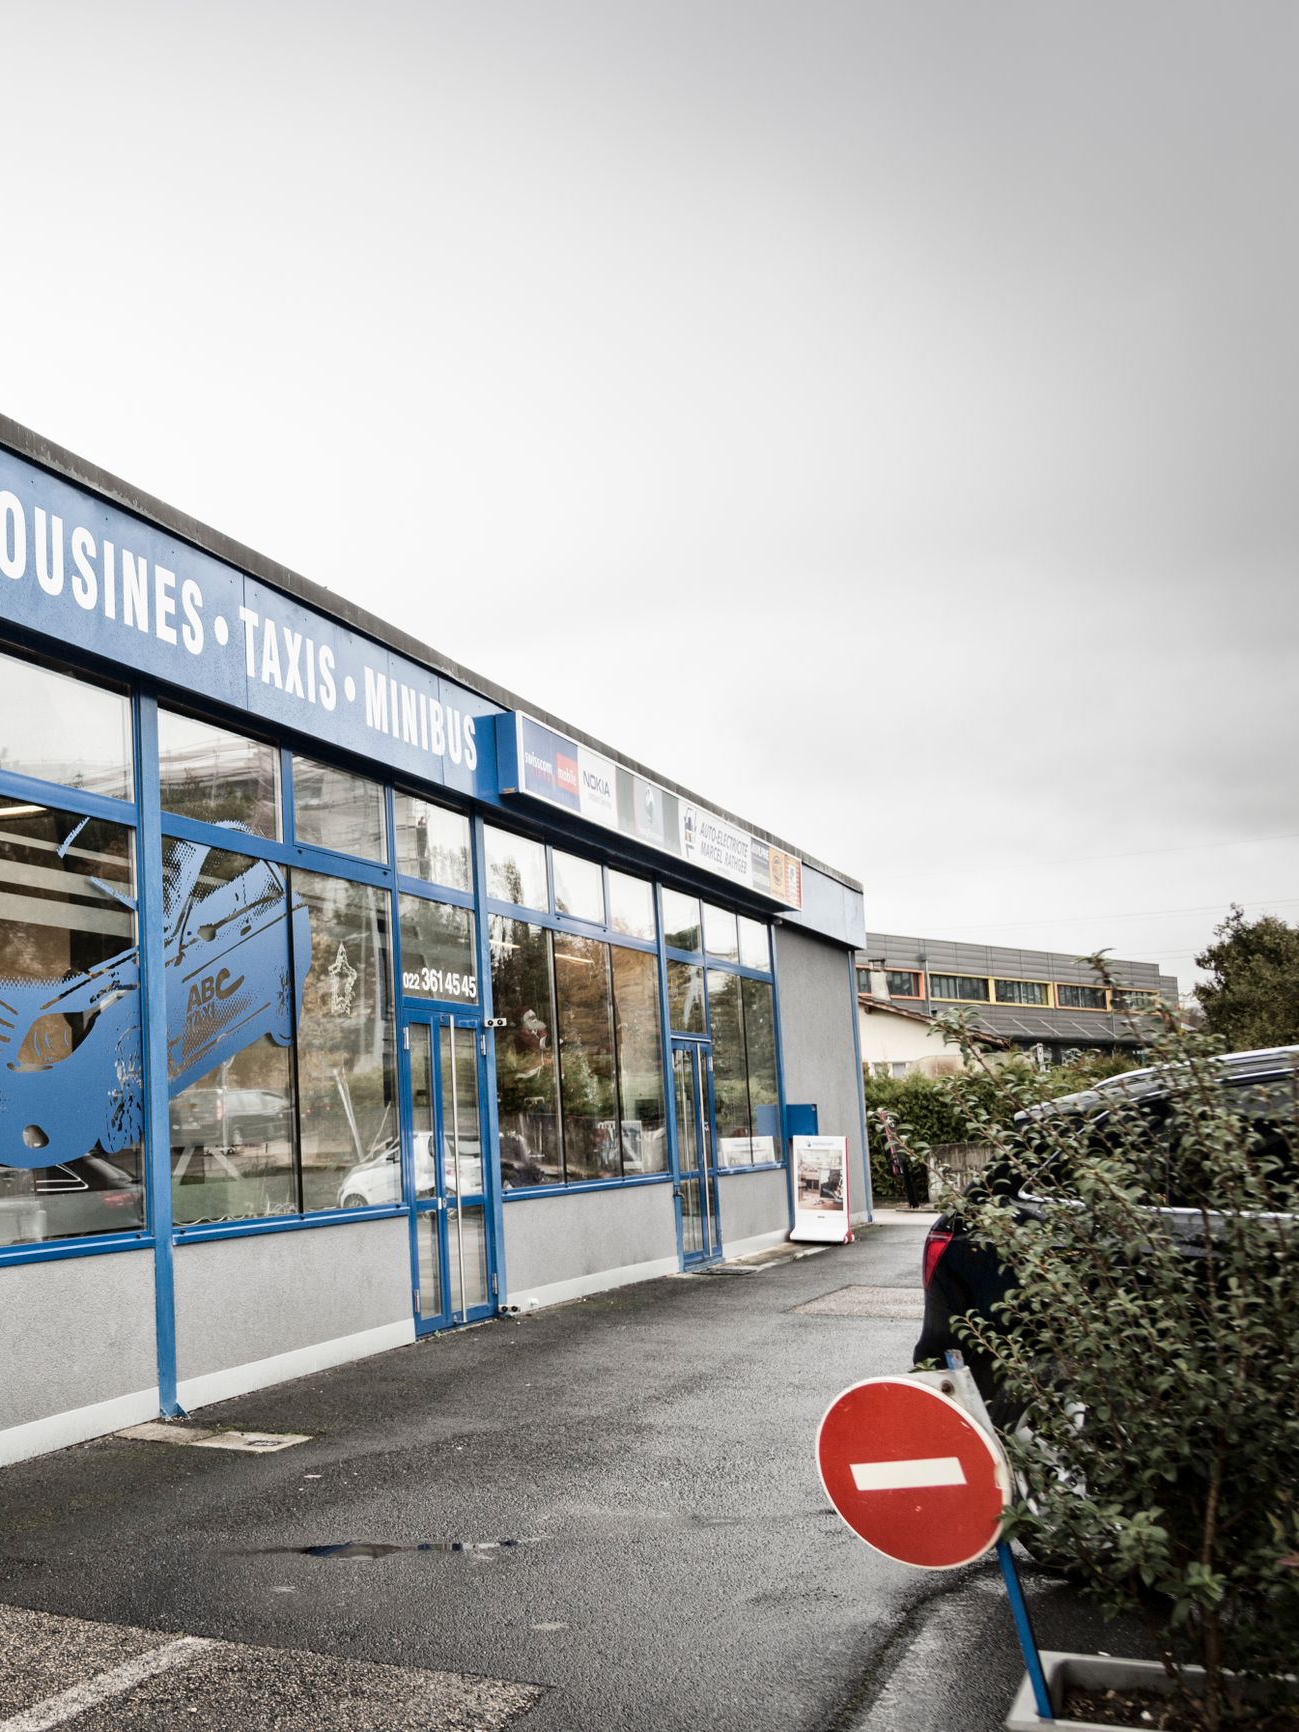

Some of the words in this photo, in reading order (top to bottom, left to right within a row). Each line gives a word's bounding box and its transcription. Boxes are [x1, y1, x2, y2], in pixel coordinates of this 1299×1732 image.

[239, 604, 337, 711] TAXIS
[364, 665, 478, 772] MINIBUS
[524, 751, 553, 774] swisscom
[582, 770, 611, 797] NOKIA
[701, 841, 723, 864] MARCEL
[186, 967, 245, 1011] ABC
[403, 971, 420, 990] 022
